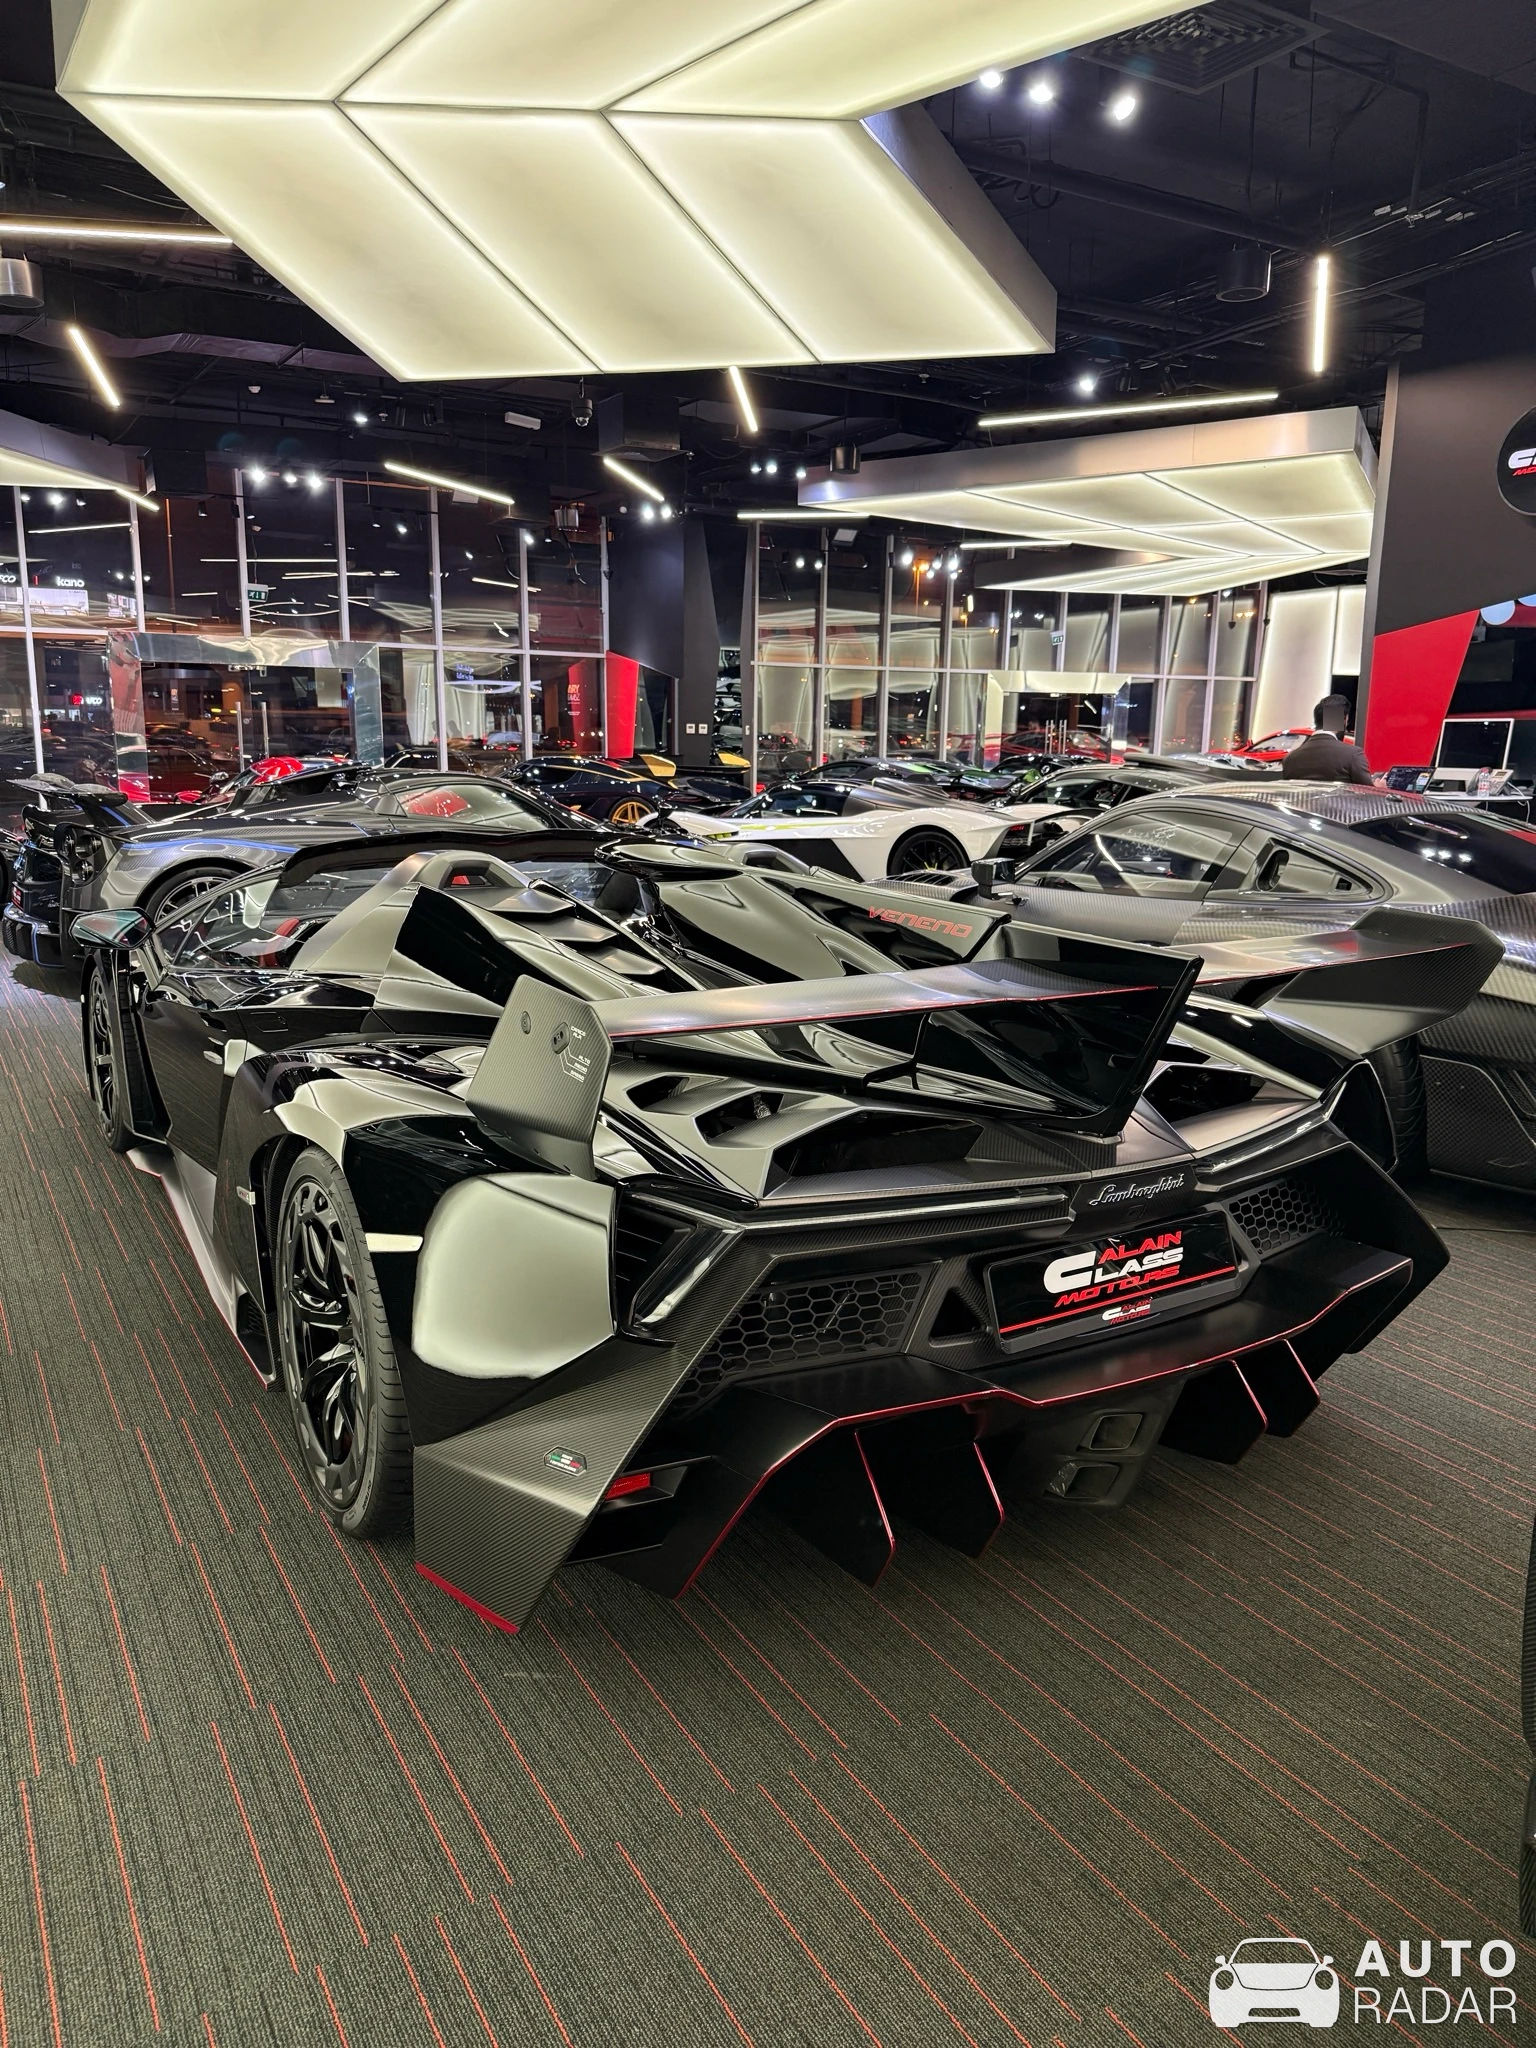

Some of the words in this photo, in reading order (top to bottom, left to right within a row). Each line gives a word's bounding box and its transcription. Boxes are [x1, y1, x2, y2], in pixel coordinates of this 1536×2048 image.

[57, 576, 85, 588] kano
[869, 906, 973, 938] VENENO
[1088, 1173, 1185, 1206] Lamborghini
[1098, 1231, 1182, 1265] ALAIN
[1043, 1246, 1184, 1294] CLASS
[1054, 1265, 1180, 1308] MOTORS
